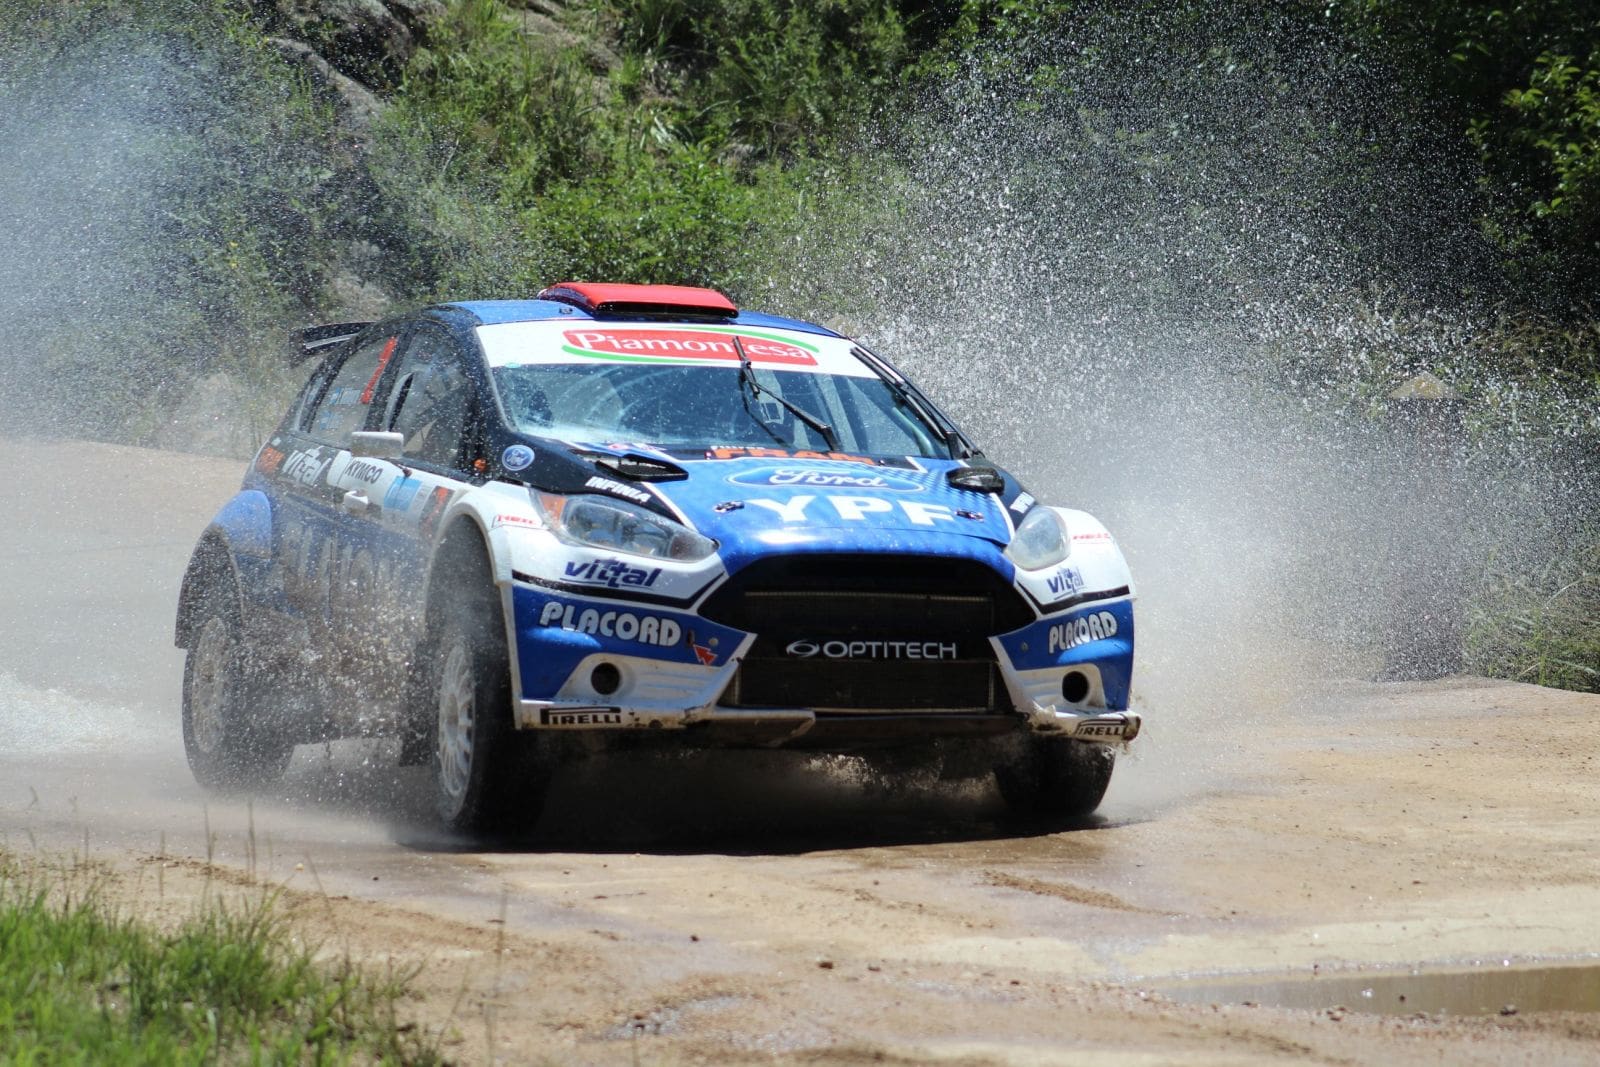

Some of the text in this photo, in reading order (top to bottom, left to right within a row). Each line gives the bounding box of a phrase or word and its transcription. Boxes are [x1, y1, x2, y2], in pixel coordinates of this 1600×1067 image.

[574, 332, 810, 359] Piamonesa
[344, 460, 384, 484] KYMCO
[769, 467, 890, 489] Ford
[584, 476, 652, 504] INFINIA
[746, 494, 955, 527] YPF
[564, 557, 663, 588] vittal
[539, 600, 682, 647] PLACORD
[1048, 611, 1118, 654] PLACORD
[823, 640, 957, 660] OPTITECH
[540, 706, 622, 725] PIRELLI
